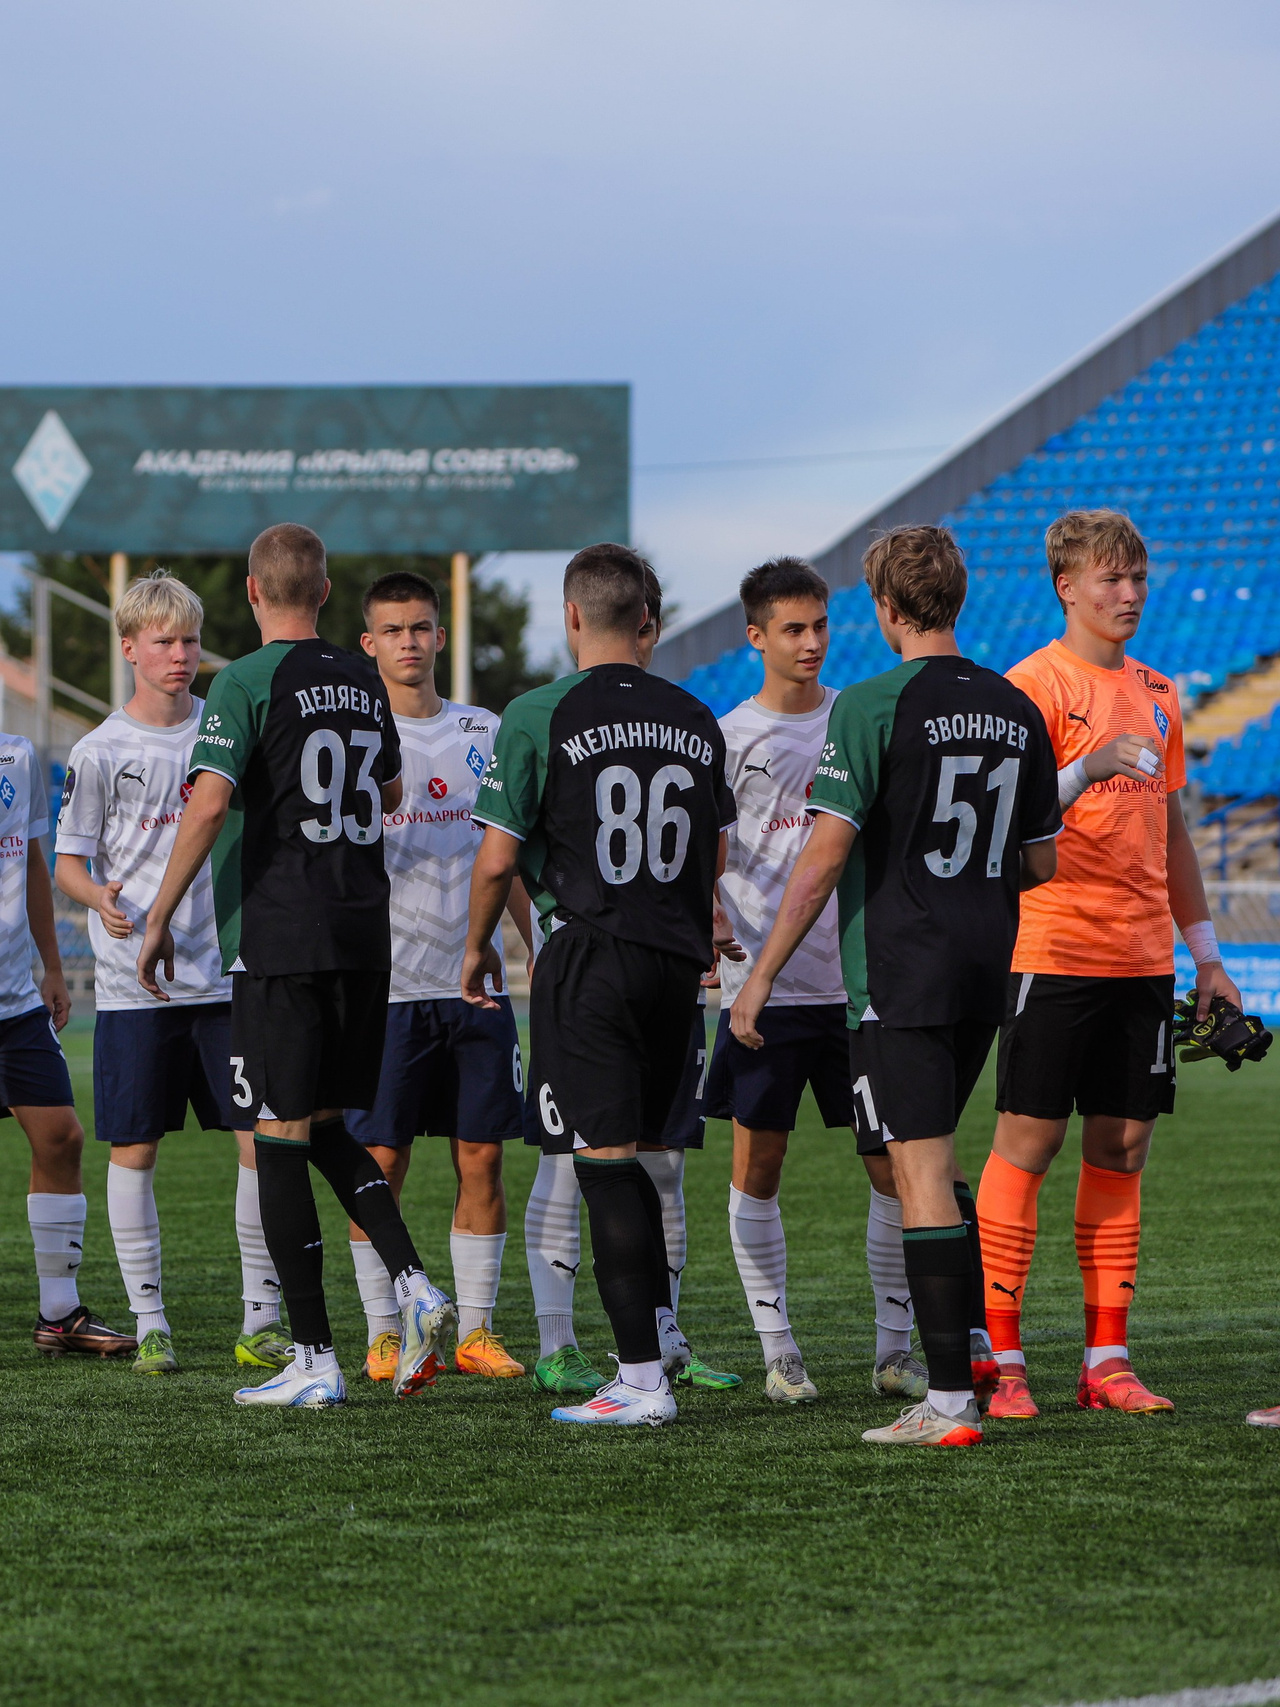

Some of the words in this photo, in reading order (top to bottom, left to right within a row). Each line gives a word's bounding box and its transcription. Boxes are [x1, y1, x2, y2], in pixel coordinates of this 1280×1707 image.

[132, 449, 295, 478] АКАДЕМИЯ
[295, 685, 370, 718] ДЕДЯЕВ
[561, 722, 714, 766] ЖЕЛАННИКОВ
[924, 713, 1029, 751] ЗВОНАРЕВ
[300, 728, 383, 845] 93
[595, 764, 695, 885] 86
[923, 756, 1020, 878] 51
[0, 849, 24, 859] БАНК
[1150, 1020, 1175, 1073] 1
[230, 1056, 253, 1108] 3
[852, 1075, 880, 1133] 1
[539, 1082, 564, 1135] 6
[303, 1345, 313, 1371] ESIGN
